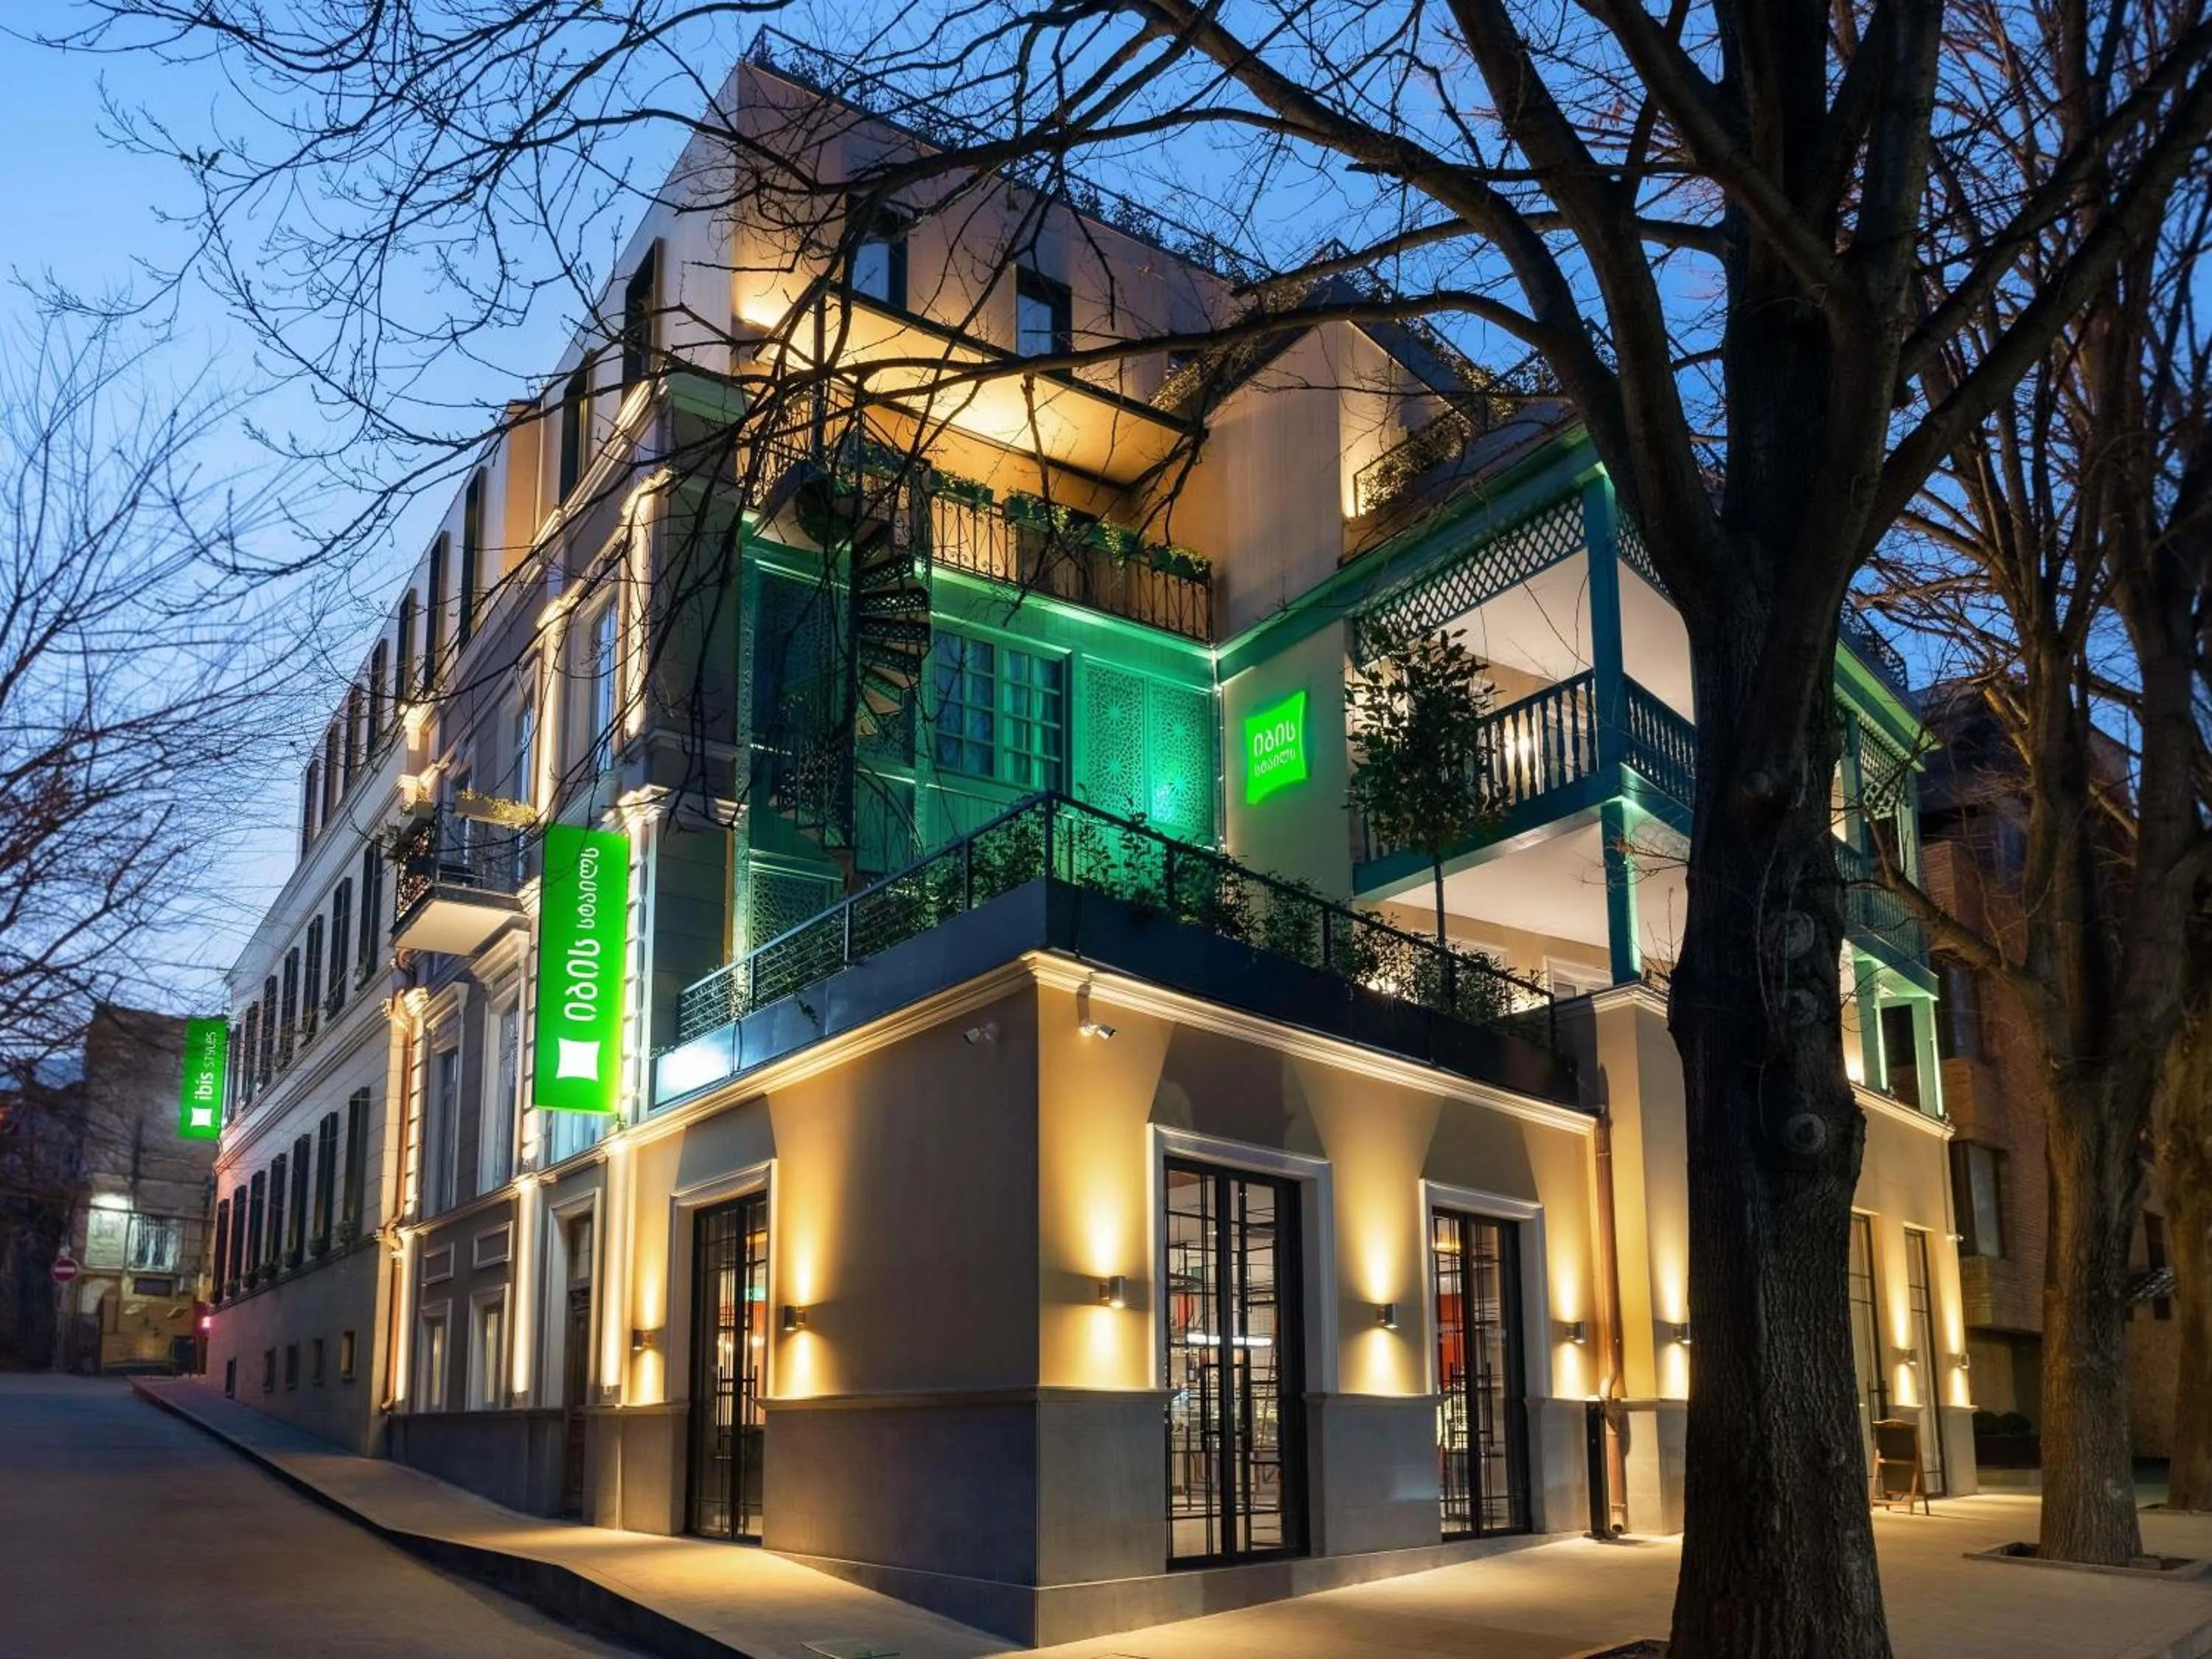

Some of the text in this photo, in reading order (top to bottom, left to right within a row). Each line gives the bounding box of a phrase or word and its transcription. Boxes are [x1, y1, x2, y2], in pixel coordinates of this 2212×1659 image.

[1253, 720, 1295, 757] იბის
[564, 847, 601, 1022] იბის სტაილს
[194, 1071, 214, 1101] ibis
